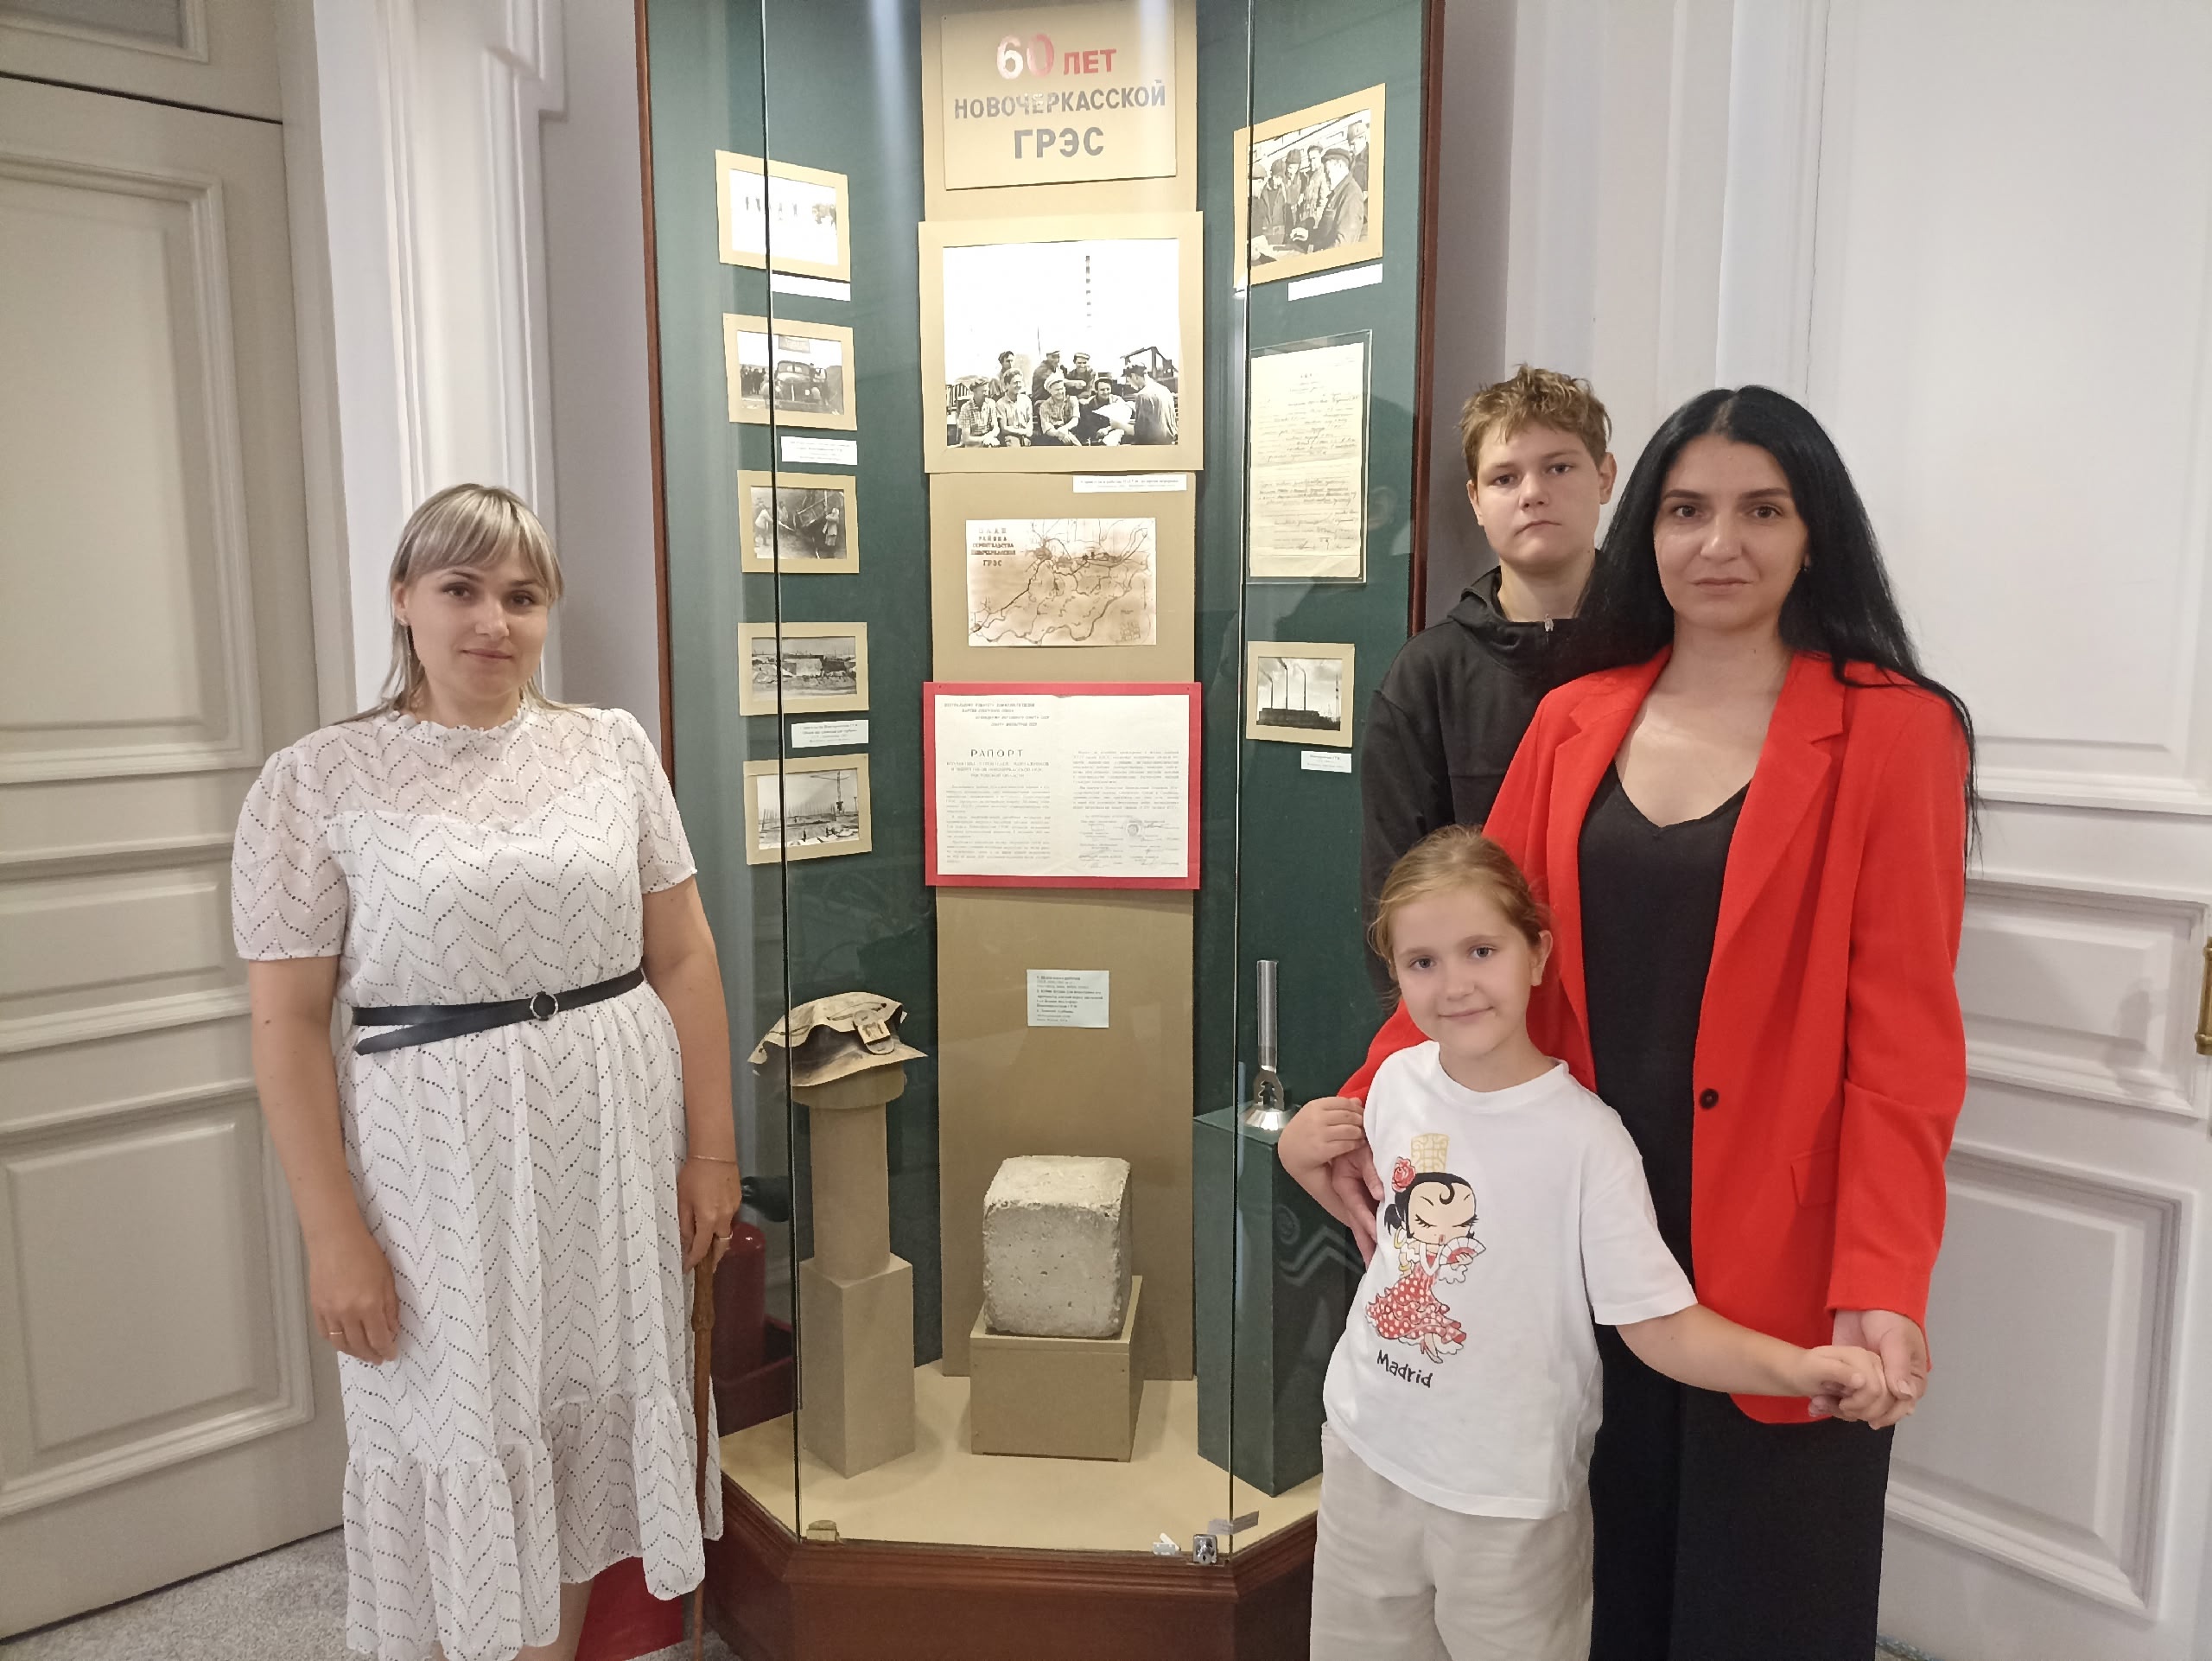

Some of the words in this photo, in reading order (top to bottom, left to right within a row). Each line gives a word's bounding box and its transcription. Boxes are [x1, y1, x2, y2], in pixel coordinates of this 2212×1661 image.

[996, 33, 1054, 80] 60
[1064, 48, 1116, 75] ЛЕТ
[955, 80, 1166, 119] НОВОЧЕРКАССКОЙ
[1014, 126, 1104, 160] ГРЭС
[970, 748, 1024, 758] РАПОРТ
[1376, 1350, 1433, 1389] Madrid
